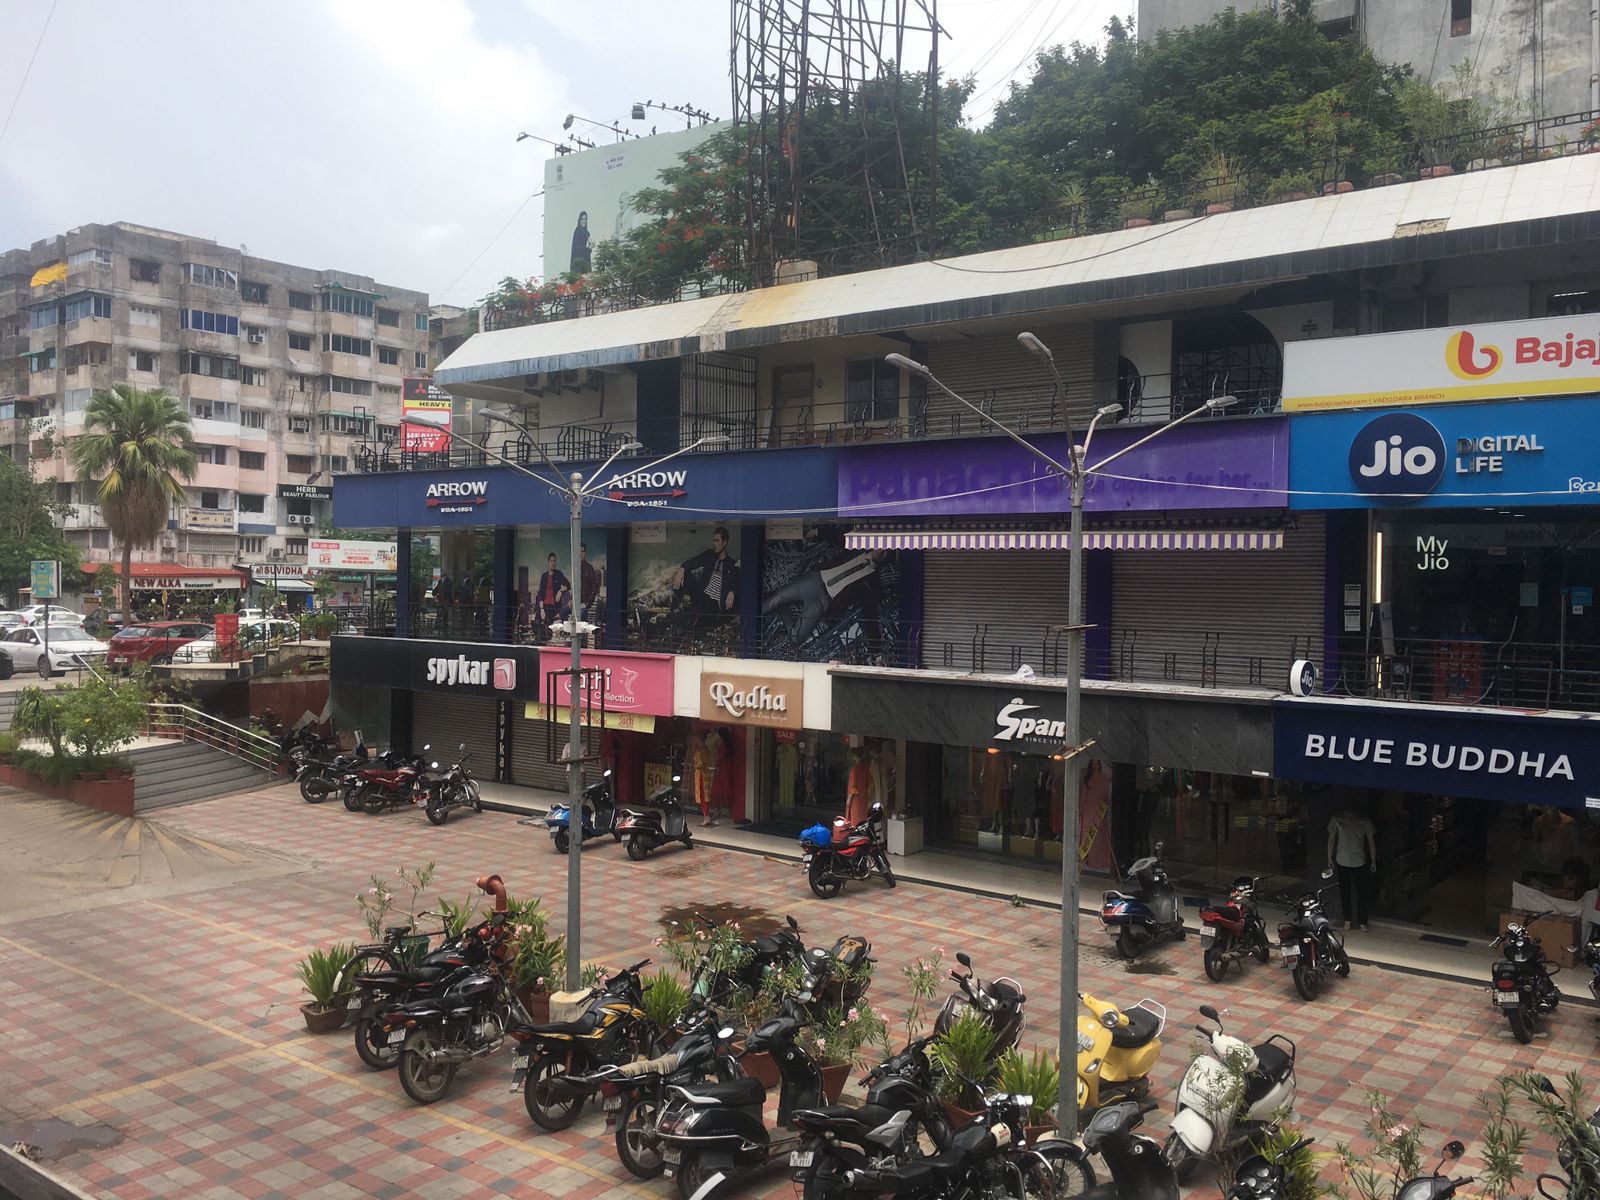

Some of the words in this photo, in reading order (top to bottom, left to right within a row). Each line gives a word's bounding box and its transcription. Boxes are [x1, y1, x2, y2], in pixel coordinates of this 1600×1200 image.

[1297, 399, 1368, 408] www.bajajcapital.com
[1373, 394, 1413, 403] VADODARA
[1414, 393, 1445, 401] BRANCH
[1456, 434, 1544, 454] DIGITAL
[1360, 435, 1437, 477] Jio
[1455, 456, 1503, 473] LIFE
[296, 485, 317, 493] HERB
[426, 481, 489, 497] ARROW
[608, 470, 687, 490] ARROW
[1416, 536, 1449, 556] My
[264, 566, 303, 575] SUVIDHA
[1417, 553, 1449, 570] Jio
[134, 578, 155, 588] NEW
[156, 578, 181, 588] ALKA
[427, 654, 490, 686] spykar
[567, 664, 612, 692] achi
[1301, 670, 1313, 688] Jio
[594, 691, 635, 704] Cllection
[709, 681, 788, 718] Radha
[993, 698, 1066, 740] Span
[777, 730, 795, 739] SALE
[1304, 734, 1395, 764] BLUE
[1405, 742, 1575, 781] BUDDHA
